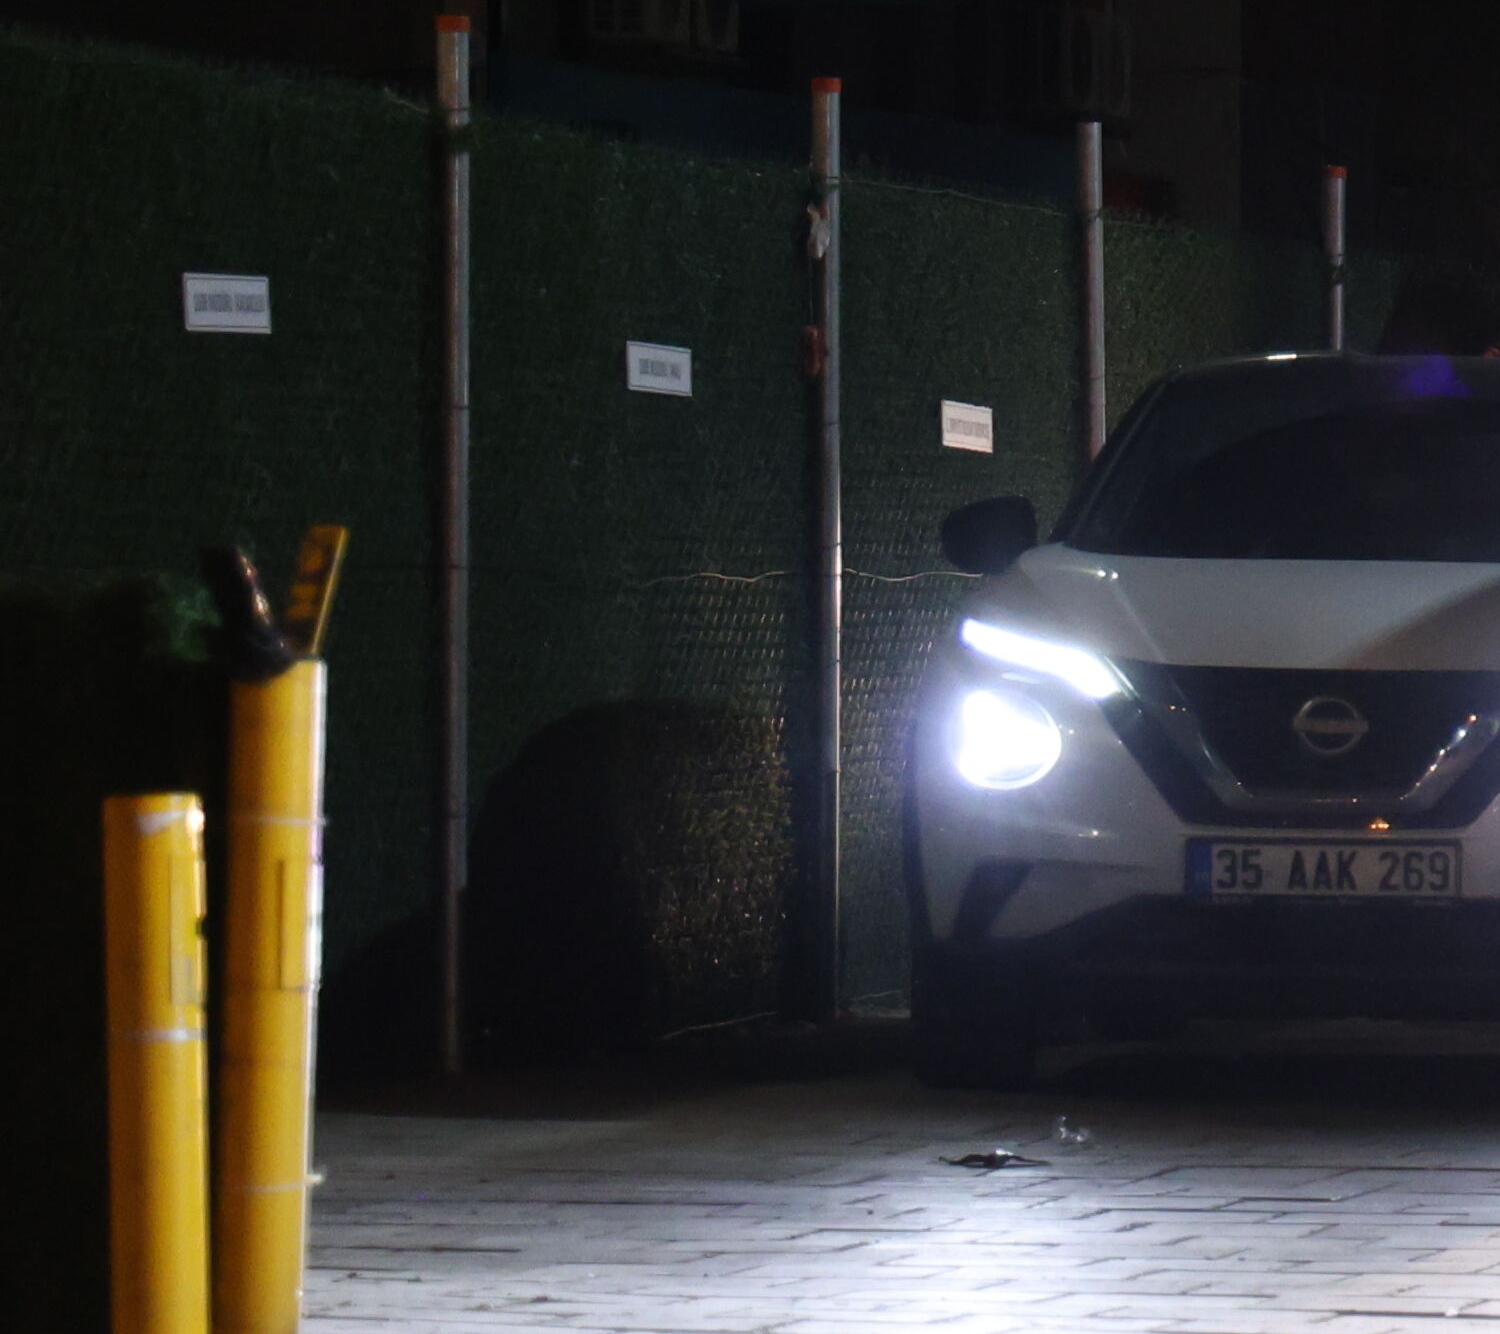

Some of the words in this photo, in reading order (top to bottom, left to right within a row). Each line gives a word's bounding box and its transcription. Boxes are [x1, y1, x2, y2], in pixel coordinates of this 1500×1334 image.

[1216, 849, 1263, 889] 35
[1288, 849, 1357, 891] AAK
[1379, 851, 1451, 891] 269
